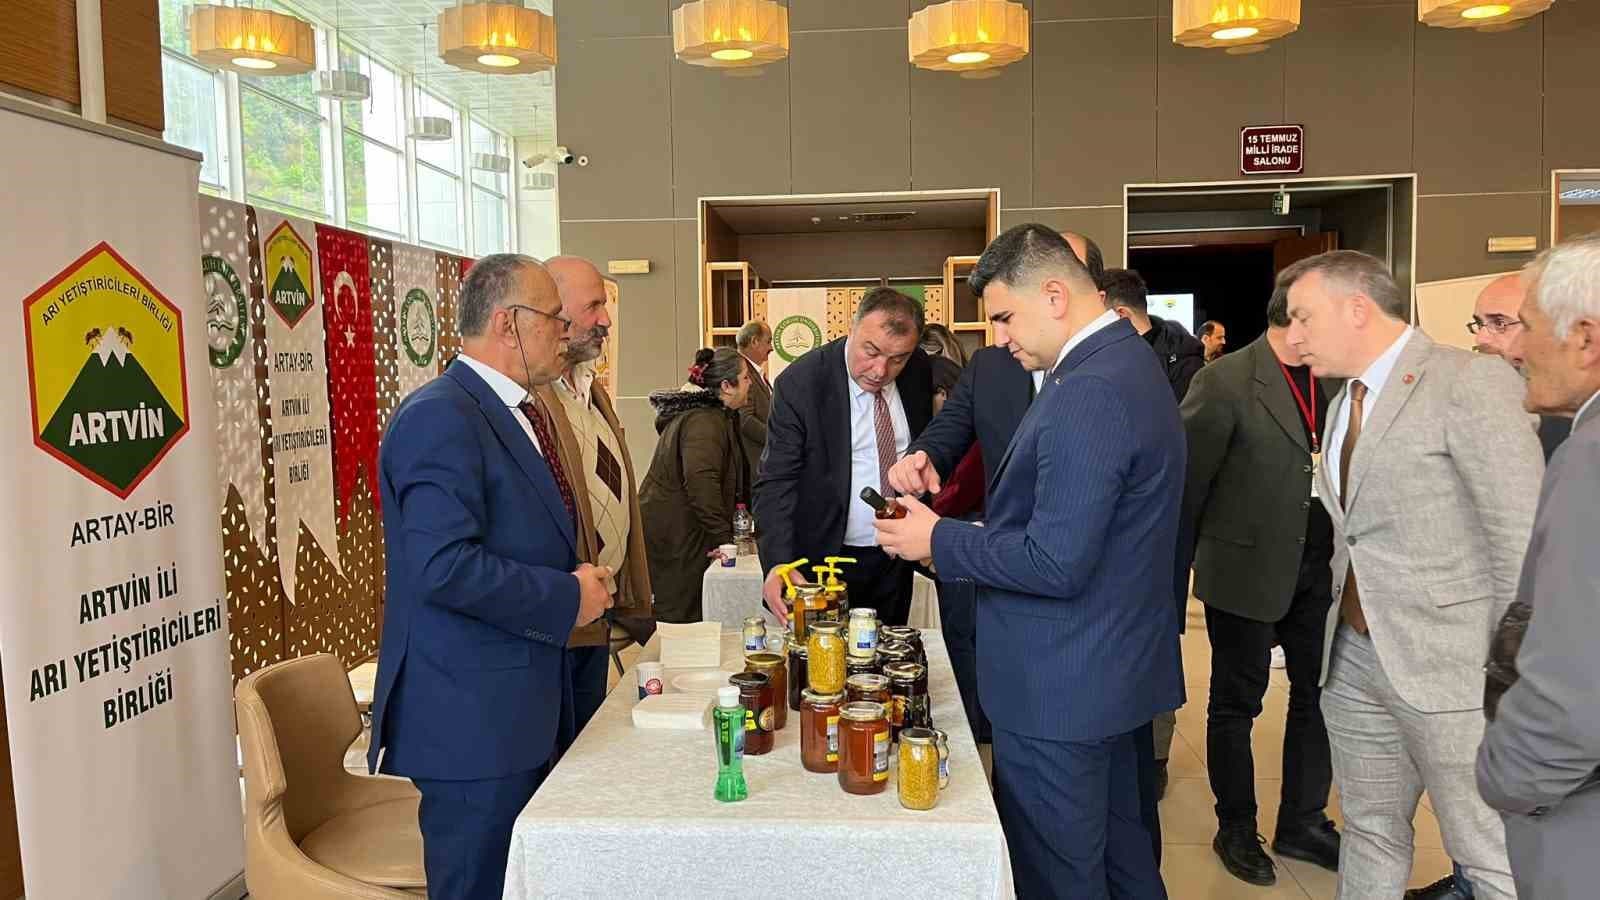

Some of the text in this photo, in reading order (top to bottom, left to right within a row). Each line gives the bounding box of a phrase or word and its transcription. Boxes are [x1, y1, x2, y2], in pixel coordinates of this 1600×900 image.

[1245, 144, 1299, 155] MİLLİ İRADE
[1248, 133, 1298, 144] 15 TEMMUZ
[1253, 156, 1291, 166] SALONU
[42, 275, 173, 332] ARI YETİŞTİRİCİLERİ BİRLİĞİ
[275, 289, 305, 306] ARTVİN
[69, 402, 165, 447] ARTVİN
[282, 394, 301, 417] ARTVİN
[71, 500, 175, 547] ARTAY-BİR
[80, 562, 178, 624] ARTVİN İLİ
[30, 599, 221, 702] ARI YETİŞTİRİCİLERİ
[103, 668, 173, 729] BİRLİĞİ
